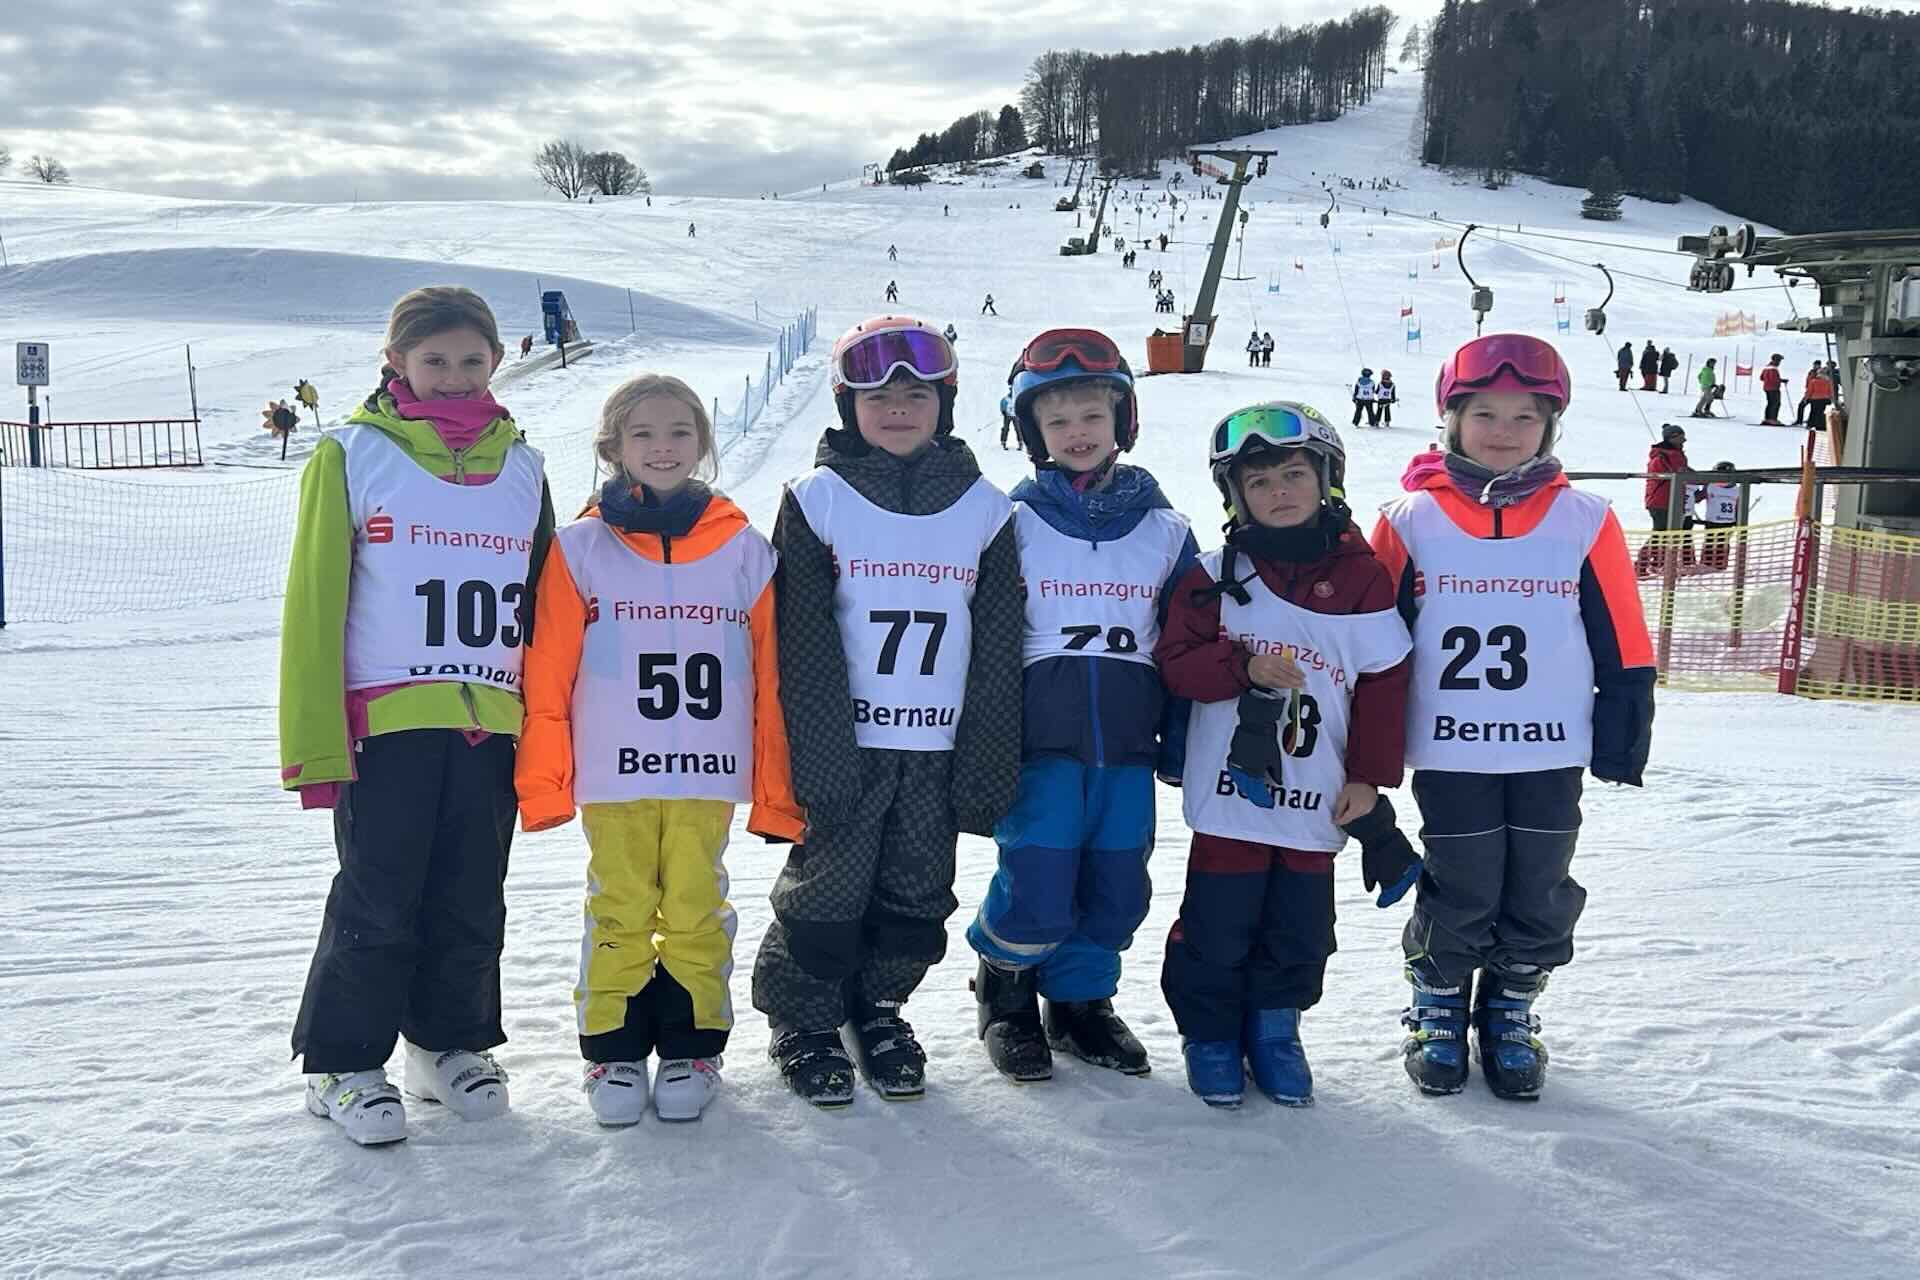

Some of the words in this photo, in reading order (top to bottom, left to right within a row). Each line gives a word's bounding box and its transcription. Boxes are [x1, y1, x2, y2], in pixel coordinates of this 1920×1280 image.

[1720, 503, 1733, 513] 83
[415, 579, 522, 648] 103
[869, 610, 948, 675] 77
[1439, 625, 1528, 690] 23
[637, 652, 722, 720] 59
[853, 698, 954, 728] Bernau
[1433, 715, 1566, 742] Bernau
[618, 747, 736, 775] Bernau
